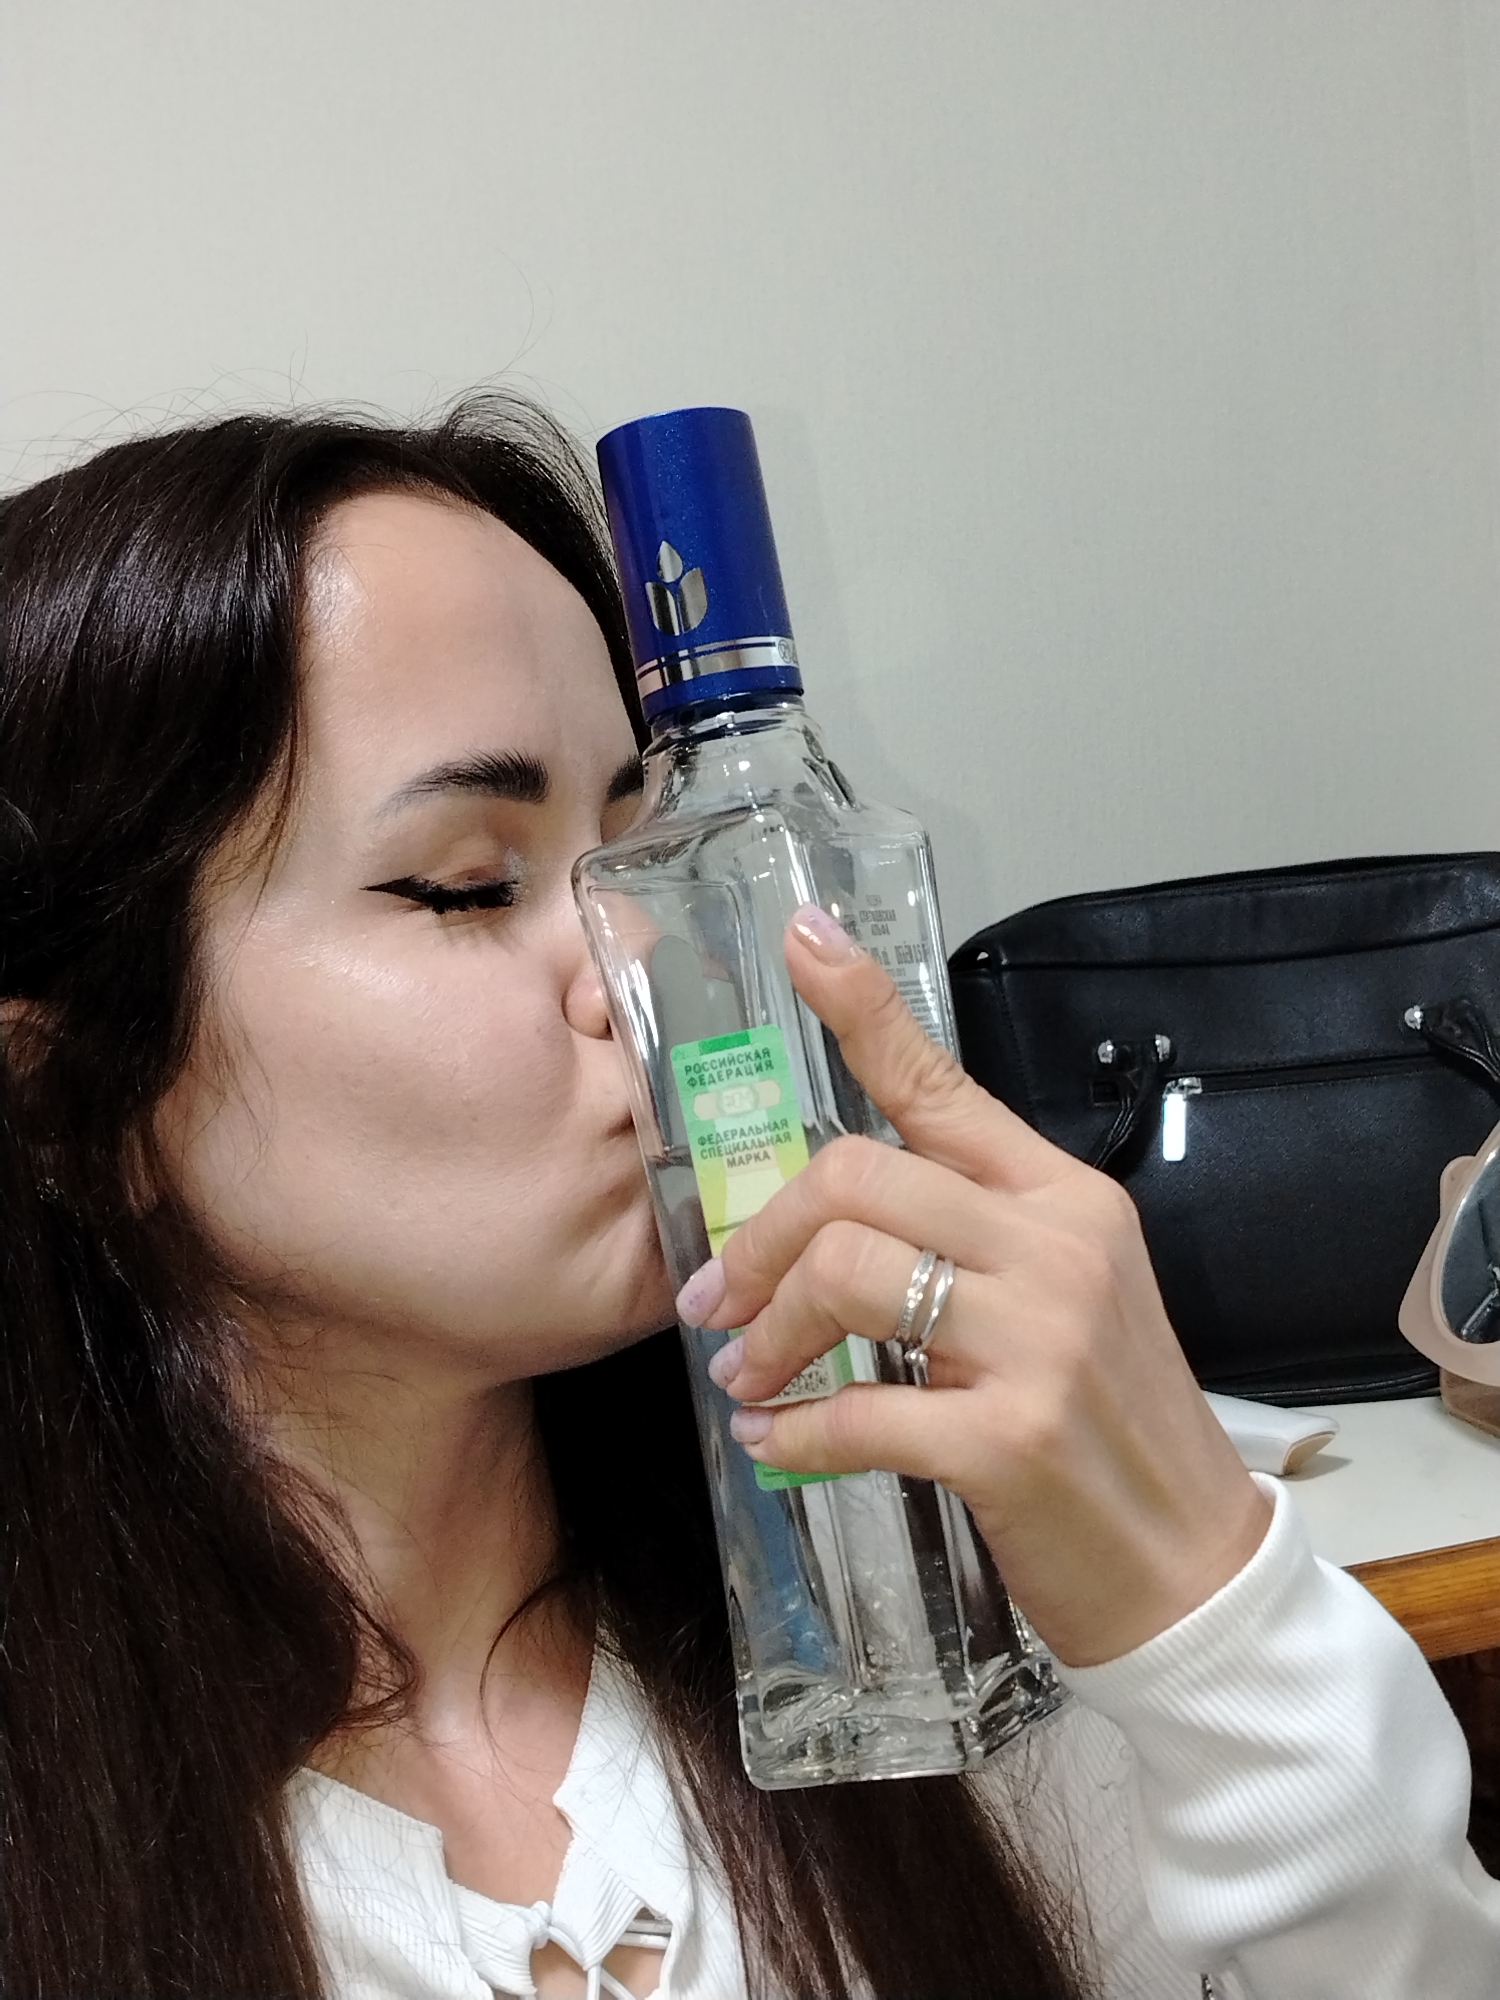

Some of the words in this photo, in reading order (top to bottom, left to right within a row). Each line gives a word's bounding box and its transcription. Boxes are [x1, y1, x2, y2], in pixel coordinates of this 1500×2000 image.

[683, 1046, 772, 1076] РОССИЙСКАЯ
[686, 1059, 775, 1088] ФЕДЕРАЦИЯ
[697, 1118, 790, 1147] ФЕДЕРАЛЬНАЯ
[700, 1131, 792, 1161] СПЕЦИАЛЬНАЯ
[726, 1149, 772, 1169] МАРКА
